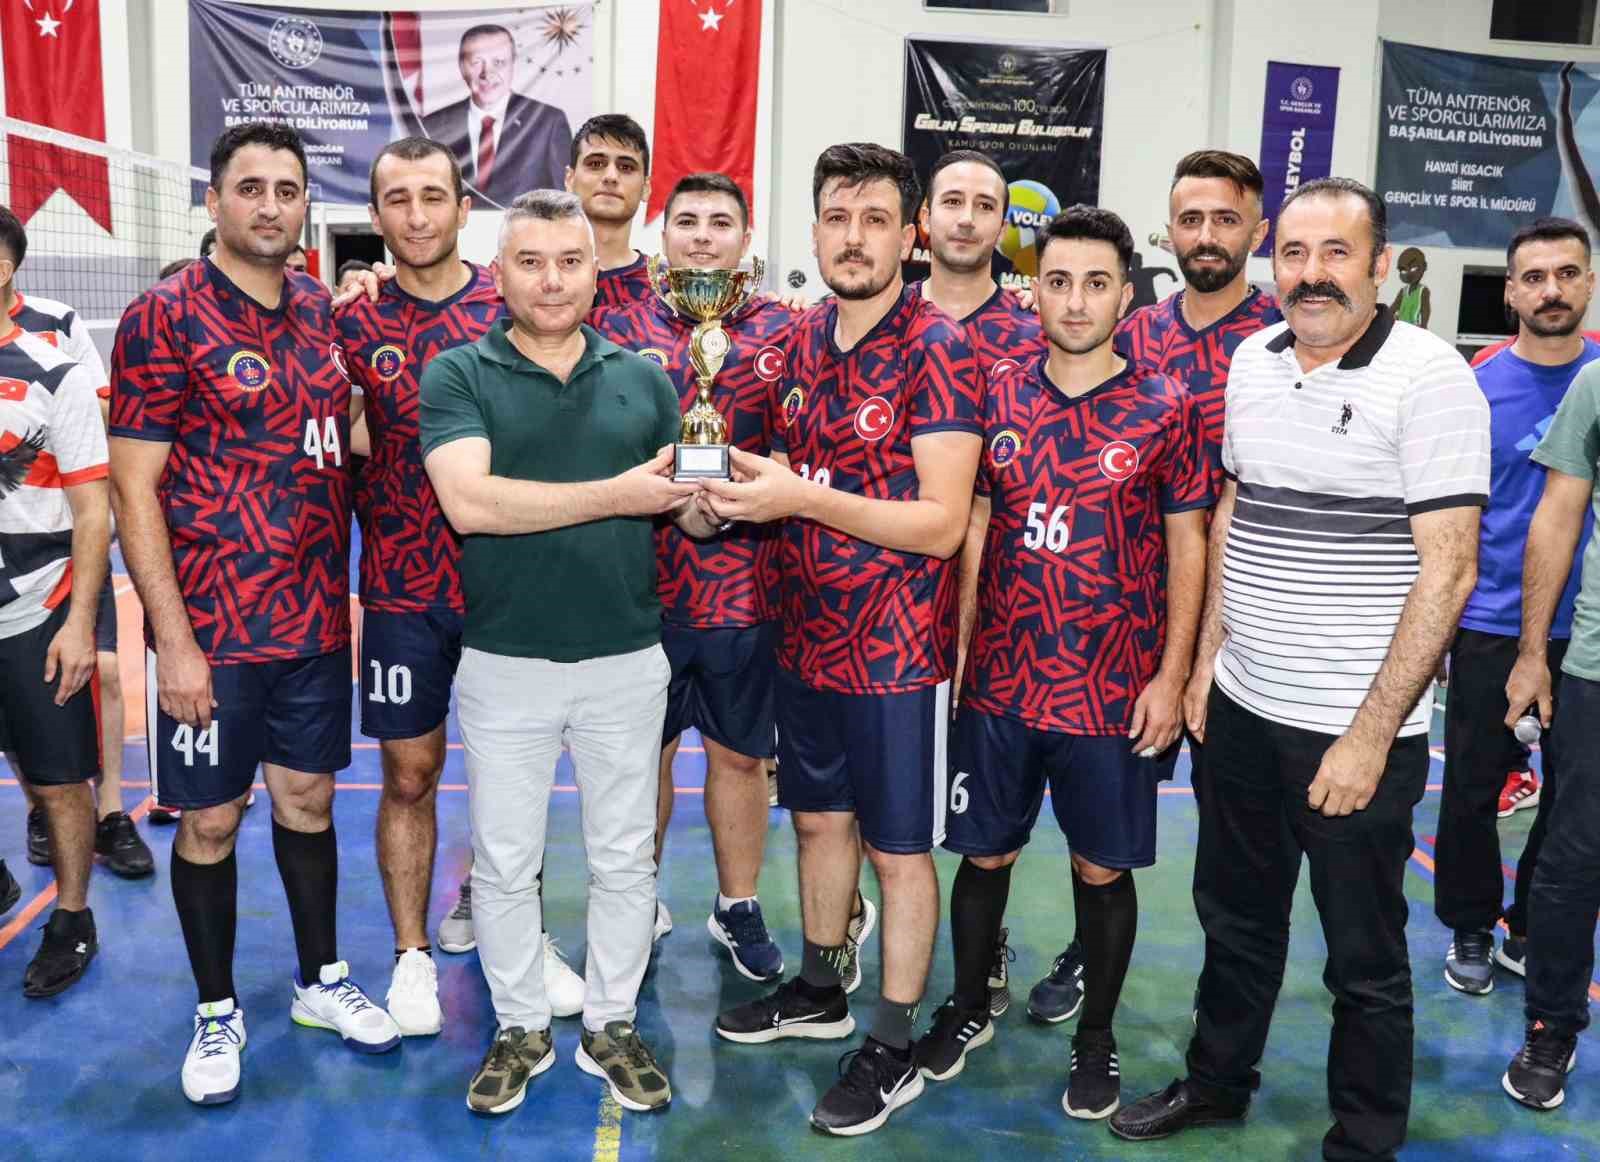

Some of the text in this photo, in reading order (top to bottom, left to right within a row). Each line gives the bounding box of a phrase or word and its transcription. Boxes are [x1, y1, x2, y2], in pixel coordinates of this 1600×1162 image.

[238, 81, 355, 100] TÜM ANTRENÖR
[1406, 87, 1531, 112] TÜM ANTRENÖR
[222, 98, 371, 115] VE SPORCULARIMIZA
[1387, 104, 1547, 131] VE SPORCULARIMIZA
[296, 117, 368, 130] DİLİYORUM
[948, 139, 976, 148] KAMU
[1389, 125, 1543, 148] BAŞARILAR DİLİYORUM
[1283, 127, 1306, 202] LEYBOL
[1425, 160, 1504, 178] HAYATİ KISACIK
[1451, 178, 1474, 192] SİİRT
[1384, 191, 1536, 213] GENÇLİK VE SPOR İL MÜDÜRÜ
[303, 416, 342, 470] 44
[1023, 502, 1071, 554] 56
[369, 659, 412, 705] 10
[171, 719, 219, 766] 44
[950, 771, 970, 814] 6
